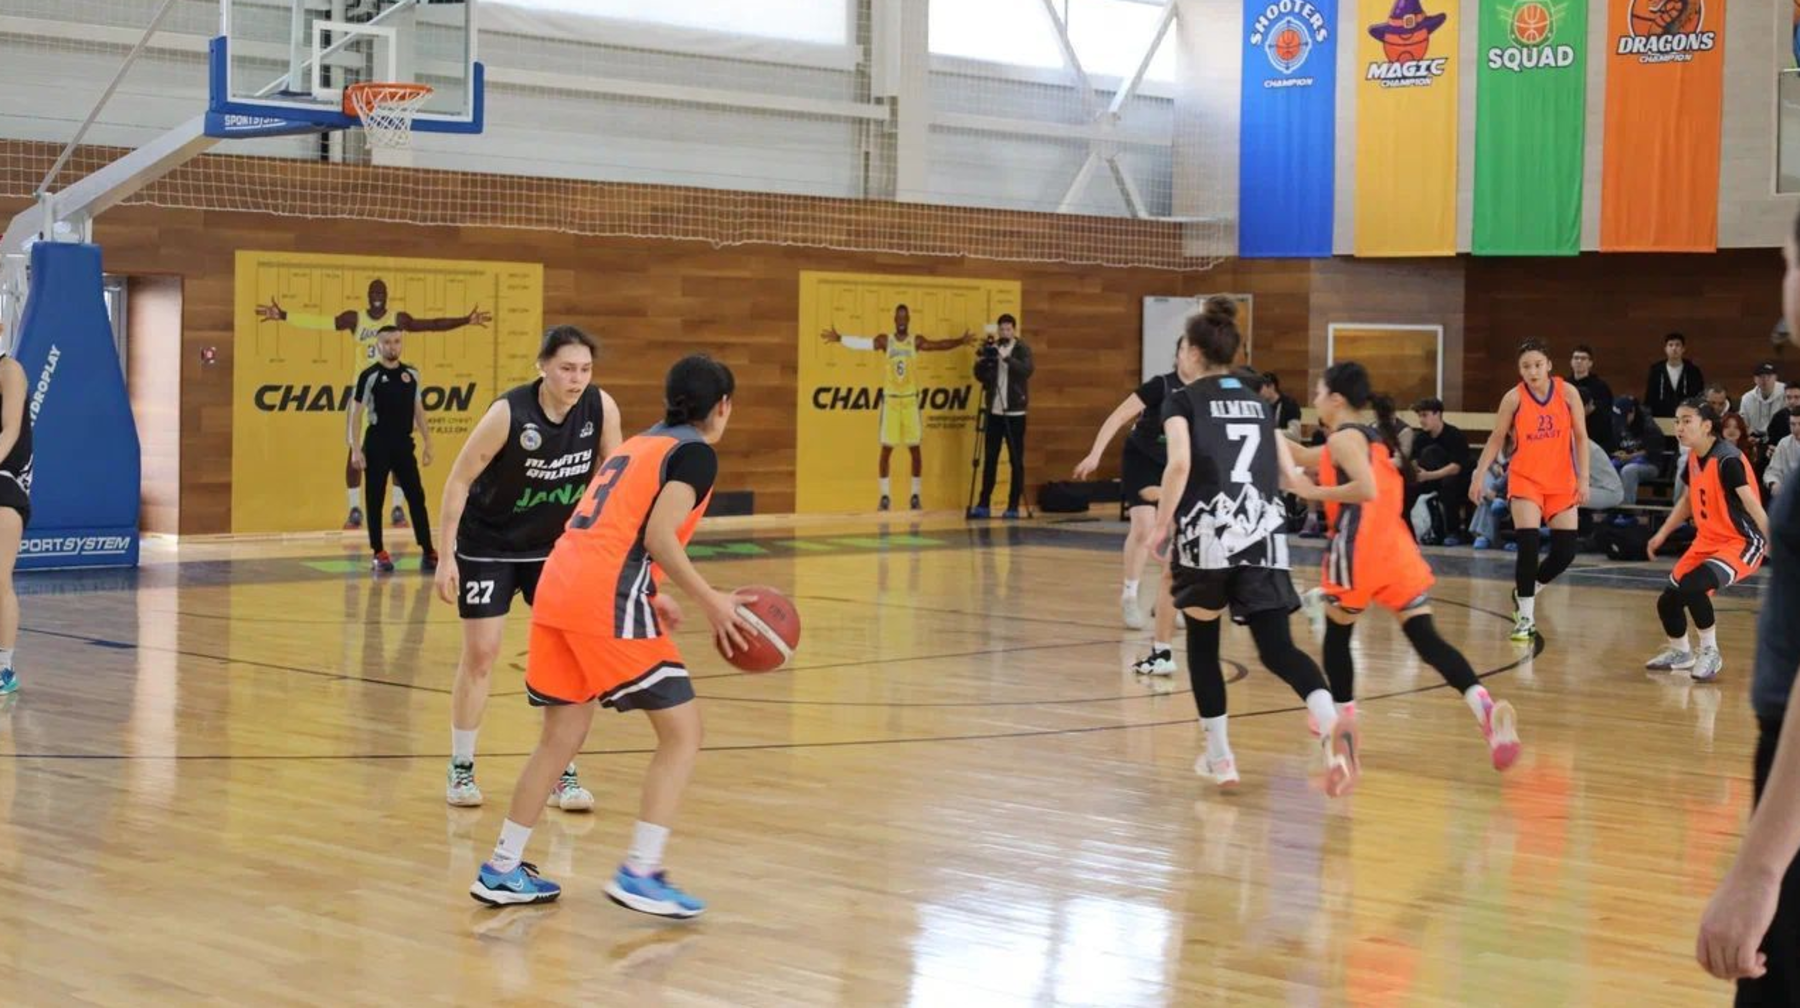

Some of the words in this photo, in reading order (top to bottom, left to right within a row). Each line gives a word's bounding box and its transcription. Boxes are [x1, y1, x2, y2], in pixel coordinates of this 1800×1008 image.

[1250, 0, 1328, 45] SHOOTERS
[1617, 32, 1714, 55] DRAGONS
[1488, 46, 1574, 71] SQUAD
[1638, 53, 1693, 63] CHAMPION
[1367, 59, 1446, 79] MAGIC
[1264, 78, 1313, 88] CHAMPION
[1381, 78, 1432, 88] CHAMPION
[31, 344, 61, 427] YDROPLAY
[1210, 400, 1265, 419] ALMATY
[1537, 415, 1553, 432] 23
[525, 449, 592, 469] ALMATY
[1226, 423, 1260, 482] 7
[570, 455, 630, 529] 3
[466, 580, 494, 604] 27
